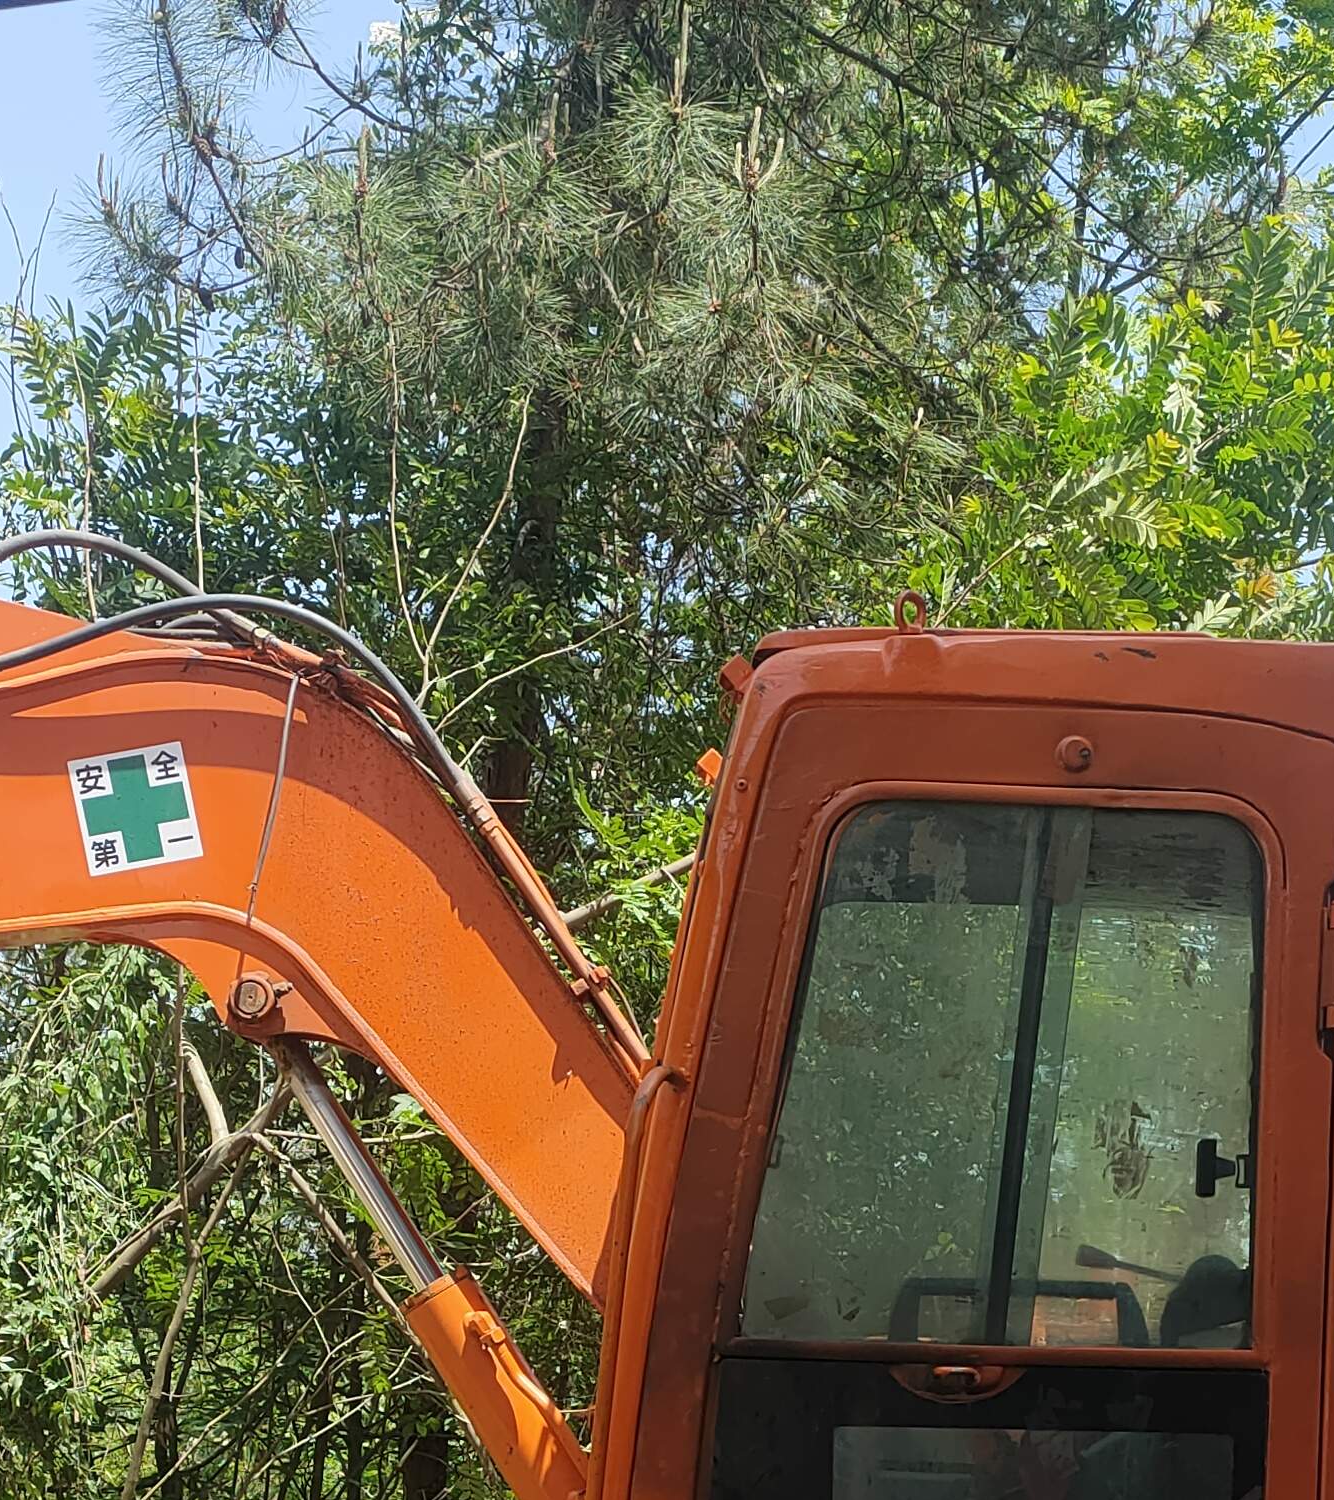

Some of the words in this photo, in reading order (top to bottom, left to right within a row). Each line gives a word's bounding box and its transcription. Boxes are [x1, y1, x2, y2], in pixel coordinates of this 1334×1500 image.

[75, 764, 106, 795] 安
[151, 750, 180, 781] 全
[91, 838, 119, 869] 第
